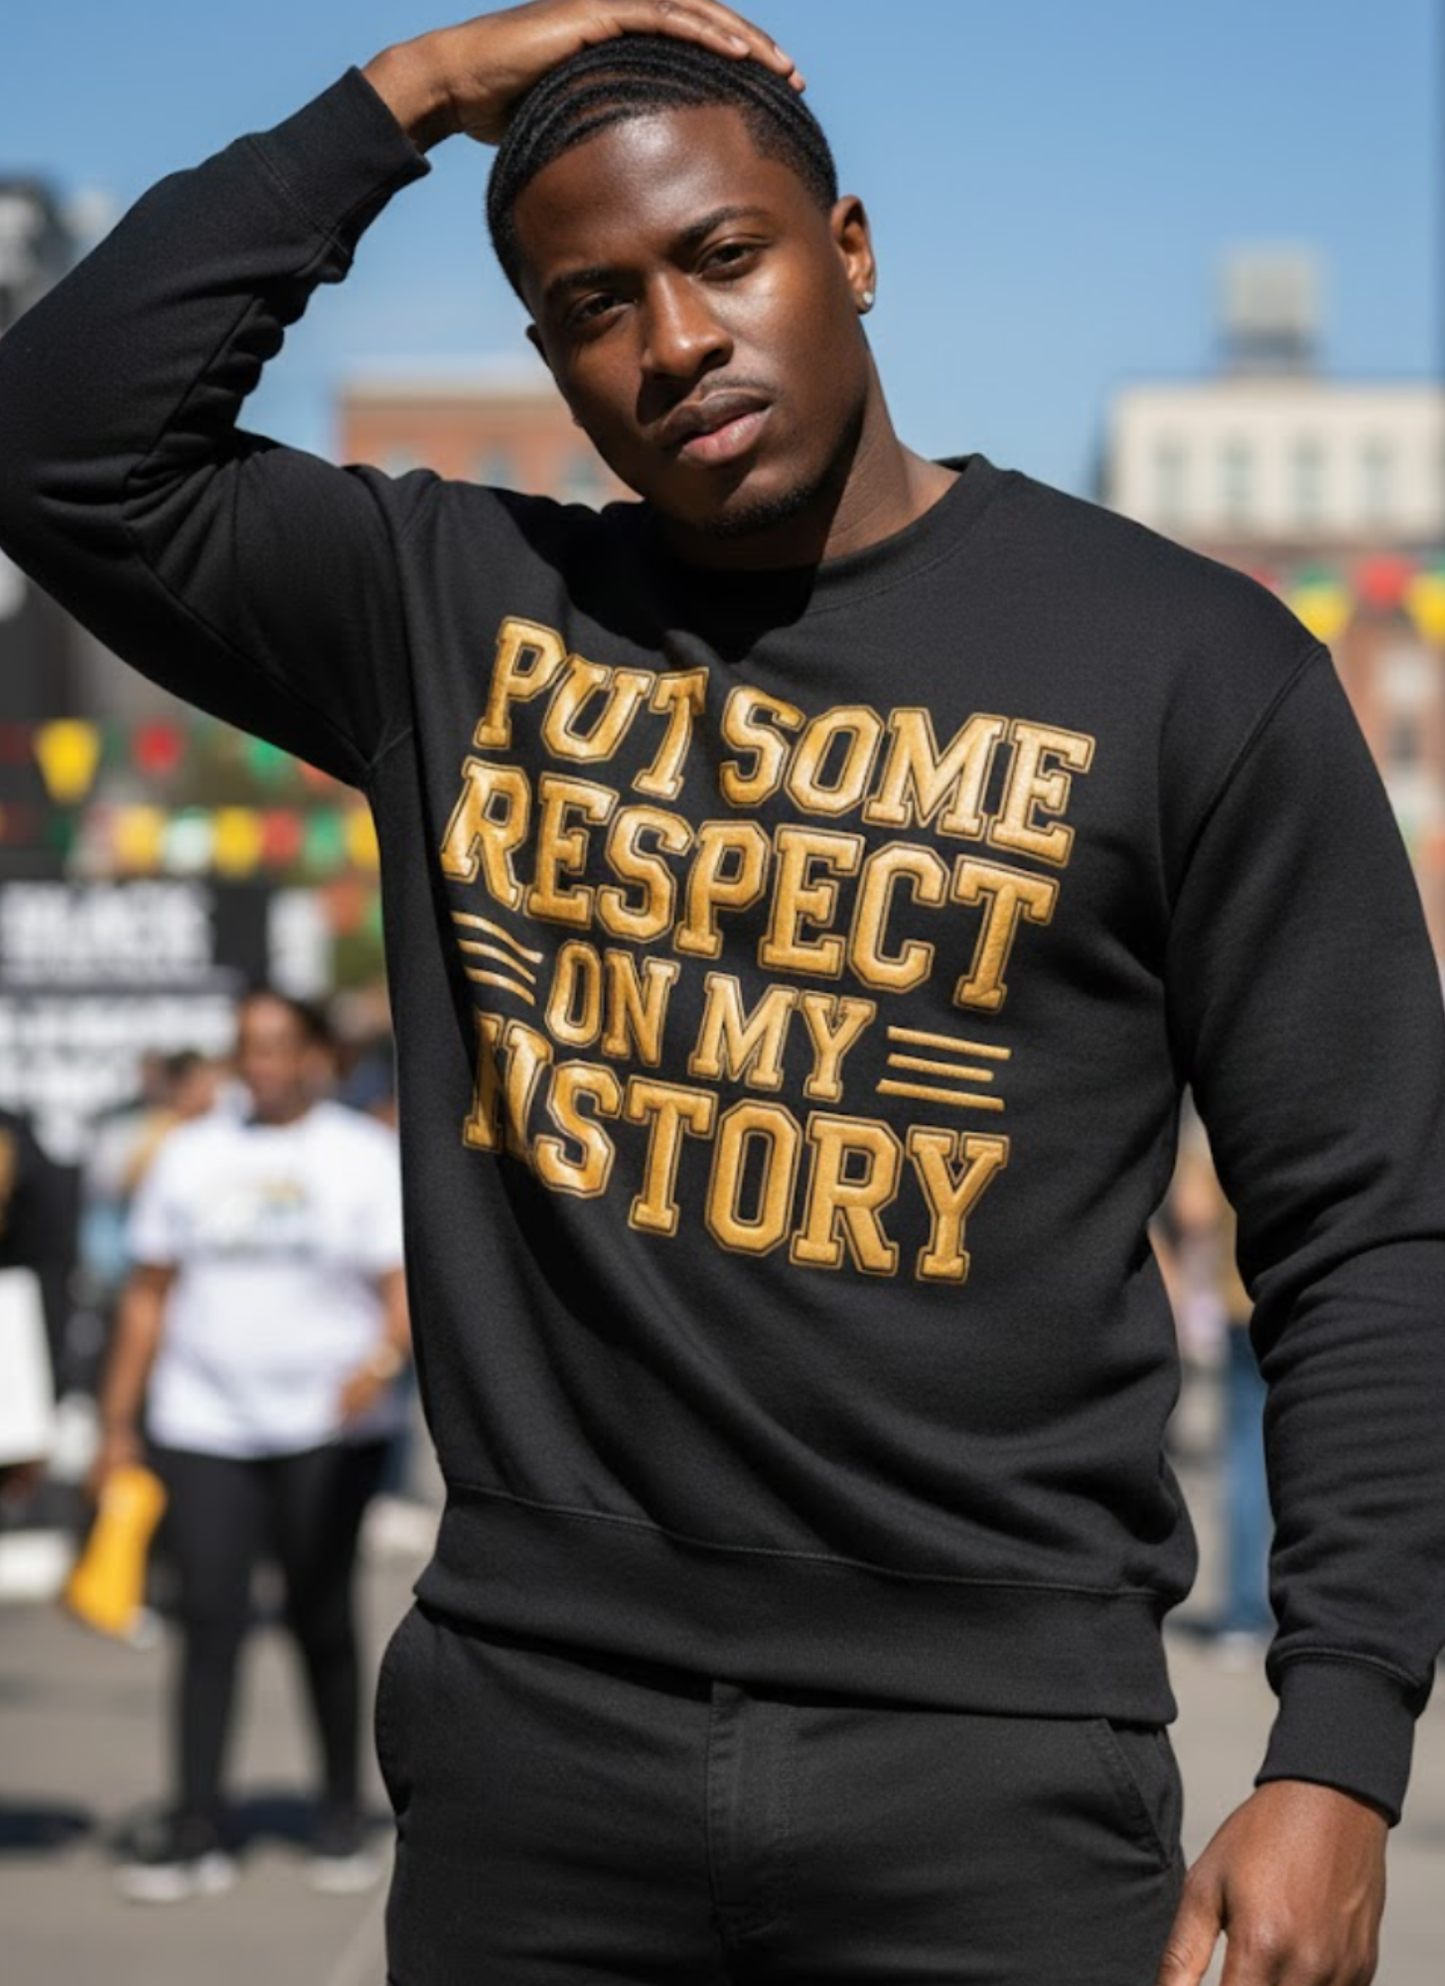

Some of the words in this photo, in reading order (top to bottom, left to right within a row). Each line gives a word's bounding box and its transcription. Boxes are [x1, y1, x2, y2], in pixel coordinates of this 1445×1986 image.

[473, 615, 710, 801] PUT
[719, 685, 1096, 868] SOME
[440, 756, 1060, 1015] RESPECT
[544, 939, 681, 1067] ON
[687, 971, 877, 1103] MY
